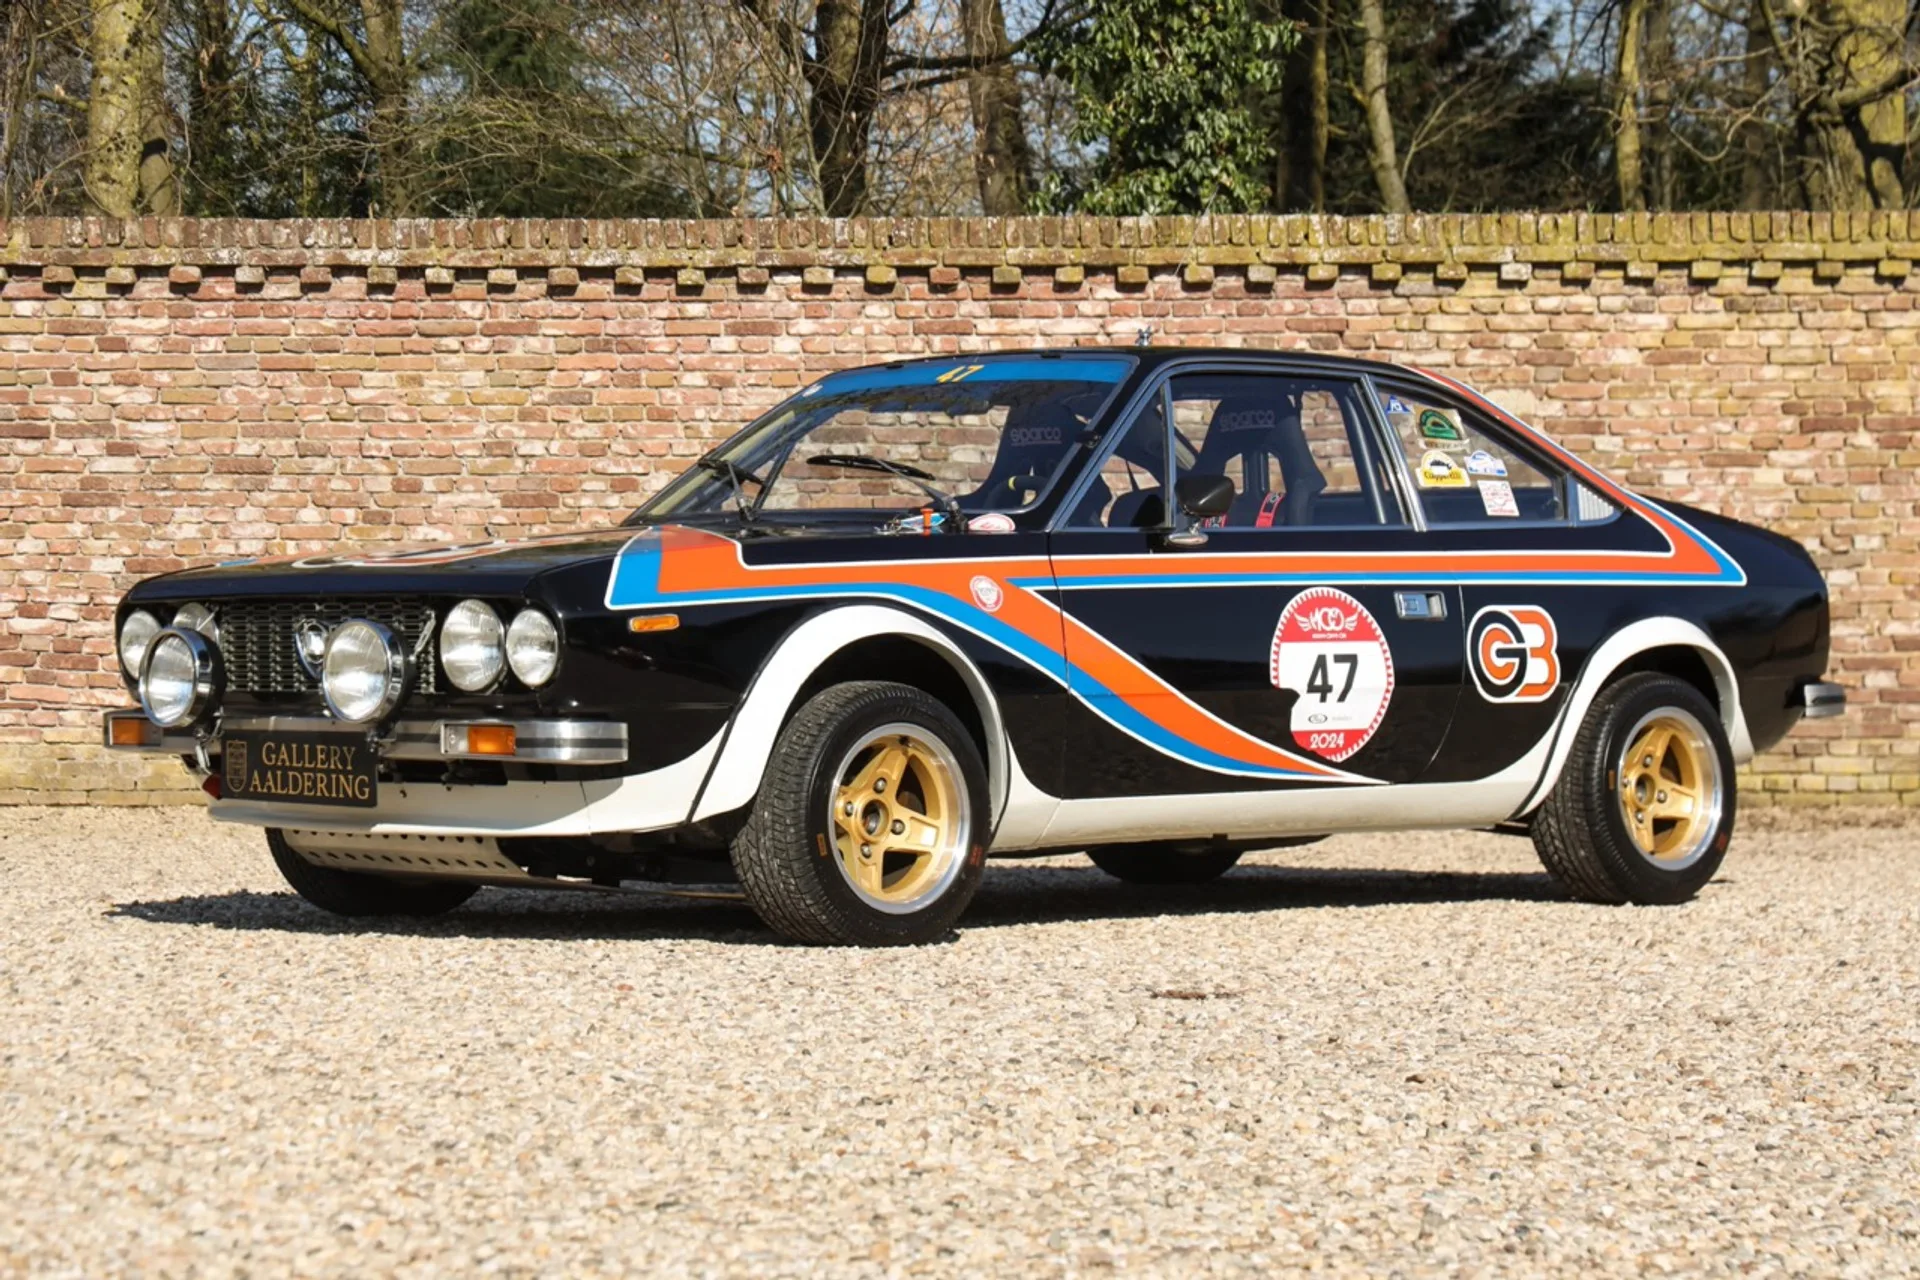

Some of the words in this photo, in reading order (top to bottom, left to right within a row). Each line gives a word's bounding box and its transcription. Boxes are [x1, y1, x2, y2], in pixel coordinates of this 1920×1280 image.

[936, 365, 985, 383] 47
[1010, 427, 1061, 444] sparco
[1306, 654, 1359, 703] 47
[1310, 733, 1345, 748] 2024
[262, 741, 356, 770] GALLERY
[249, 770, 370, 800] AALDERING
